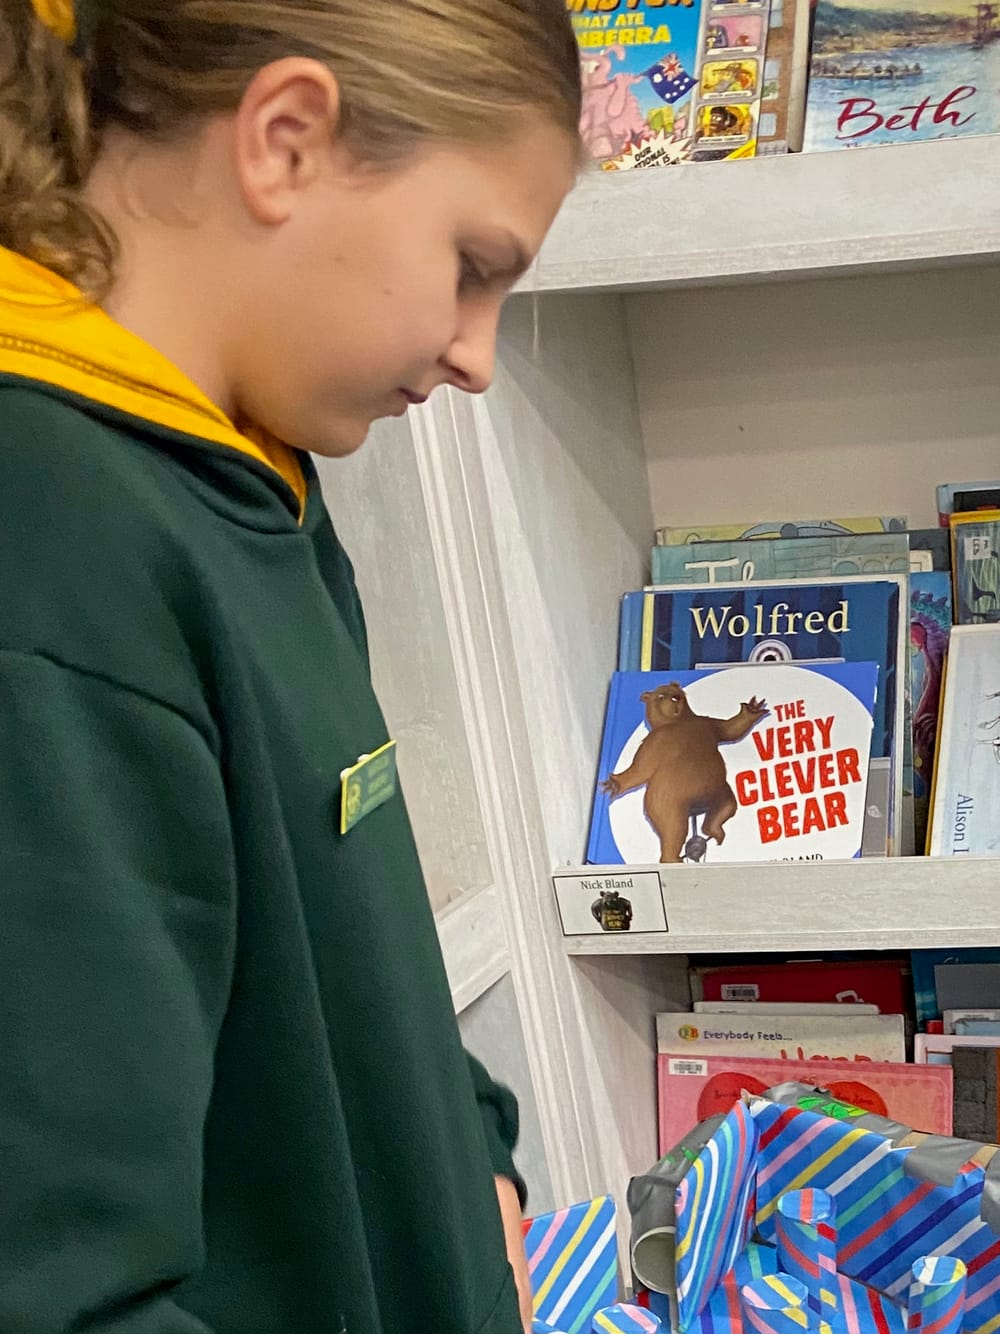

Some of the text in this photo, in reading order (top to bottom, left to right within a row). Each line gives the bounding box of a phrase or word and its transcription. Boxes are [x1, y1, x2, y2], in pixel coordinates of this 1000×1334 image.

[615, 12, 645, 26] ATE
[835, 86, 977, 140] Beth
[689, 601, 850, 639] Wolfred
[774, 700, 806, 722] THE
[752, 715, 835, 761] VERY
[735, 747, 862, 806] CLEVER
[756, 791, 849, 844] BEAR
[953, 793, 974, 842] Alison
[580, 878, 634, 889] Nick Bland
[703, 1030, 754, 1041] Everybody
